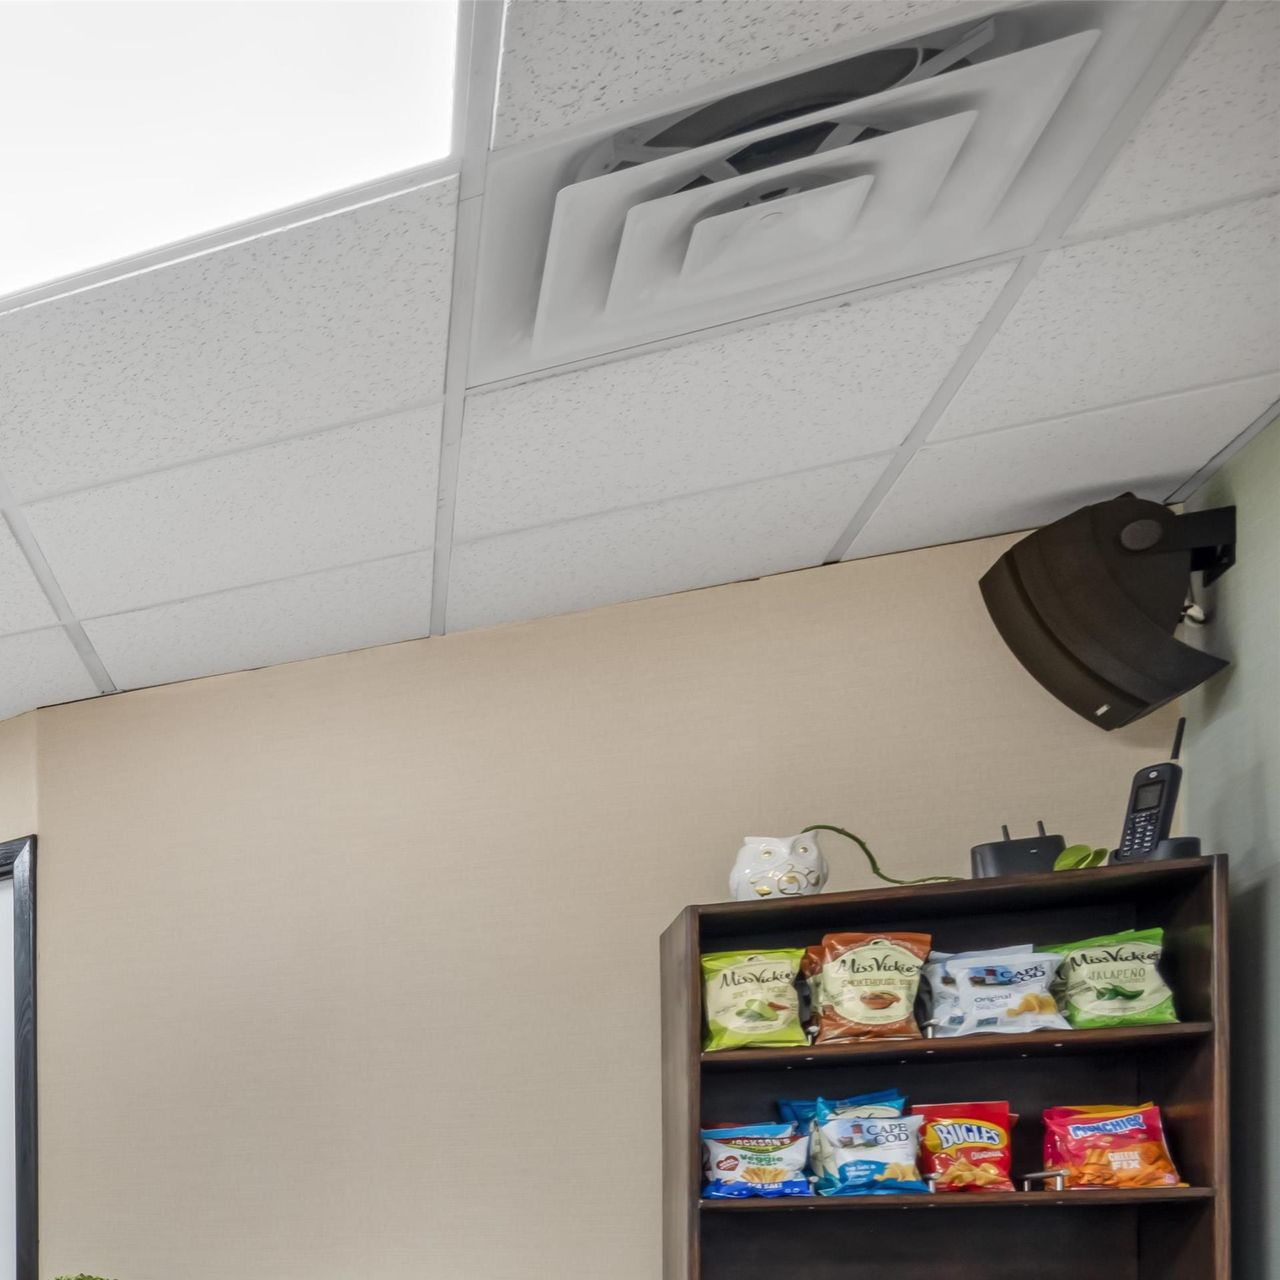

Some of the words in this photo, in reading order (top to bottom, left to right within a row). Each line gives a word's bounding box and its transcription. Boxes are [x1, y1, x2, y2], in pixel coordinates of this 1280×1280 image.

[1000, 963, 1046, 980] CAPE
[1008, 970, 1046, 985] COD
[974, 993, 1012, 1004] Original
[866, 1123, 908, 1136] CAPE
[1069, 1114, 1146, 1139] MUNCHIES
[874, 1133, 909, 1145] COD
[933, 1124, 1000, 1149] BUGLES
[740, 1154, 783, 1163] Veggie
[1112, 1161, 1140, 1169] FIX
